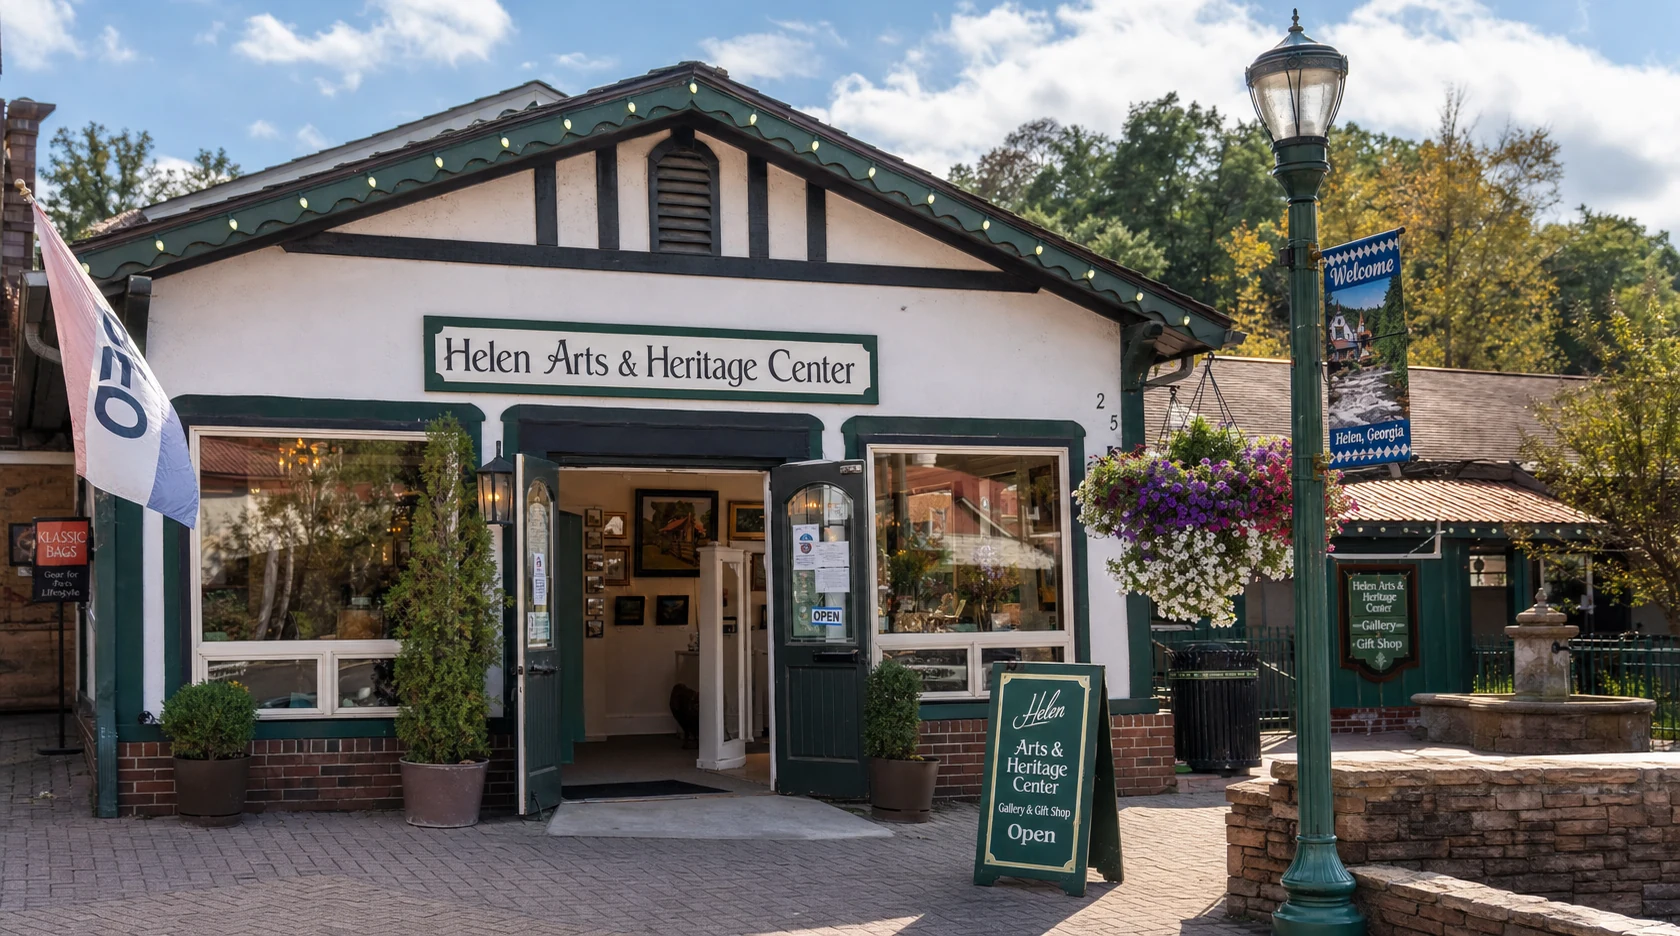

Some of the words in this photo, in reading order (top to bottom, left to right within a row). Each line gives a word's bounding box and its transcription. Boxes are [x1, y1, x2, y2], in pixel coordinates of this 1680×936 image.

[1329, 257, 1395, 287] Welcome
[444, 337, 531, 374] Helen
[543, 339, 609, 377] Arts
[618, 350, 639, 378] &
[646, 345, 758, 387] Heritage
[768, 349, 856, 384] Center
[1096, 392, 1105, 409] 2
[1109, 414, 1118, 431] 5
[1335, 429, 1365, 446] Helen,
[1367, 422, 1405, 443] Georgia
[38, 531, 86, 544] KLASSIC
[46, 545, 77, 558] BAGS
[1352, 581, 1377, 591] Helen
[1378, 581, 1396, 591] Arts
[1396, 581, 1404, 591] &
[1362, 592, 1397, 604] Heritage
[813, 611, 840, 623] OPEN
[1361, 620, 1396, 632] Gallery
[1356, 639, 1375, 650] Gift
[1377, 638, 1403, 651] Shop
[1012, 689, 1065, 730] Helen
[1014, 739, 1048, 757] Arts
[1051, 741, 1064, 758] &
[1006, 757, 1068, 780] Heritage
[1012, 776, 1059, 795] Center
[998, 802, 1025, 816] Gallery
[1026, 804, 1033, 815] &
[1034, 804, 1049, 817] Gift
[1050, 806, 1071, 820] Shop
[1007, 823, 1056, 846] Open
